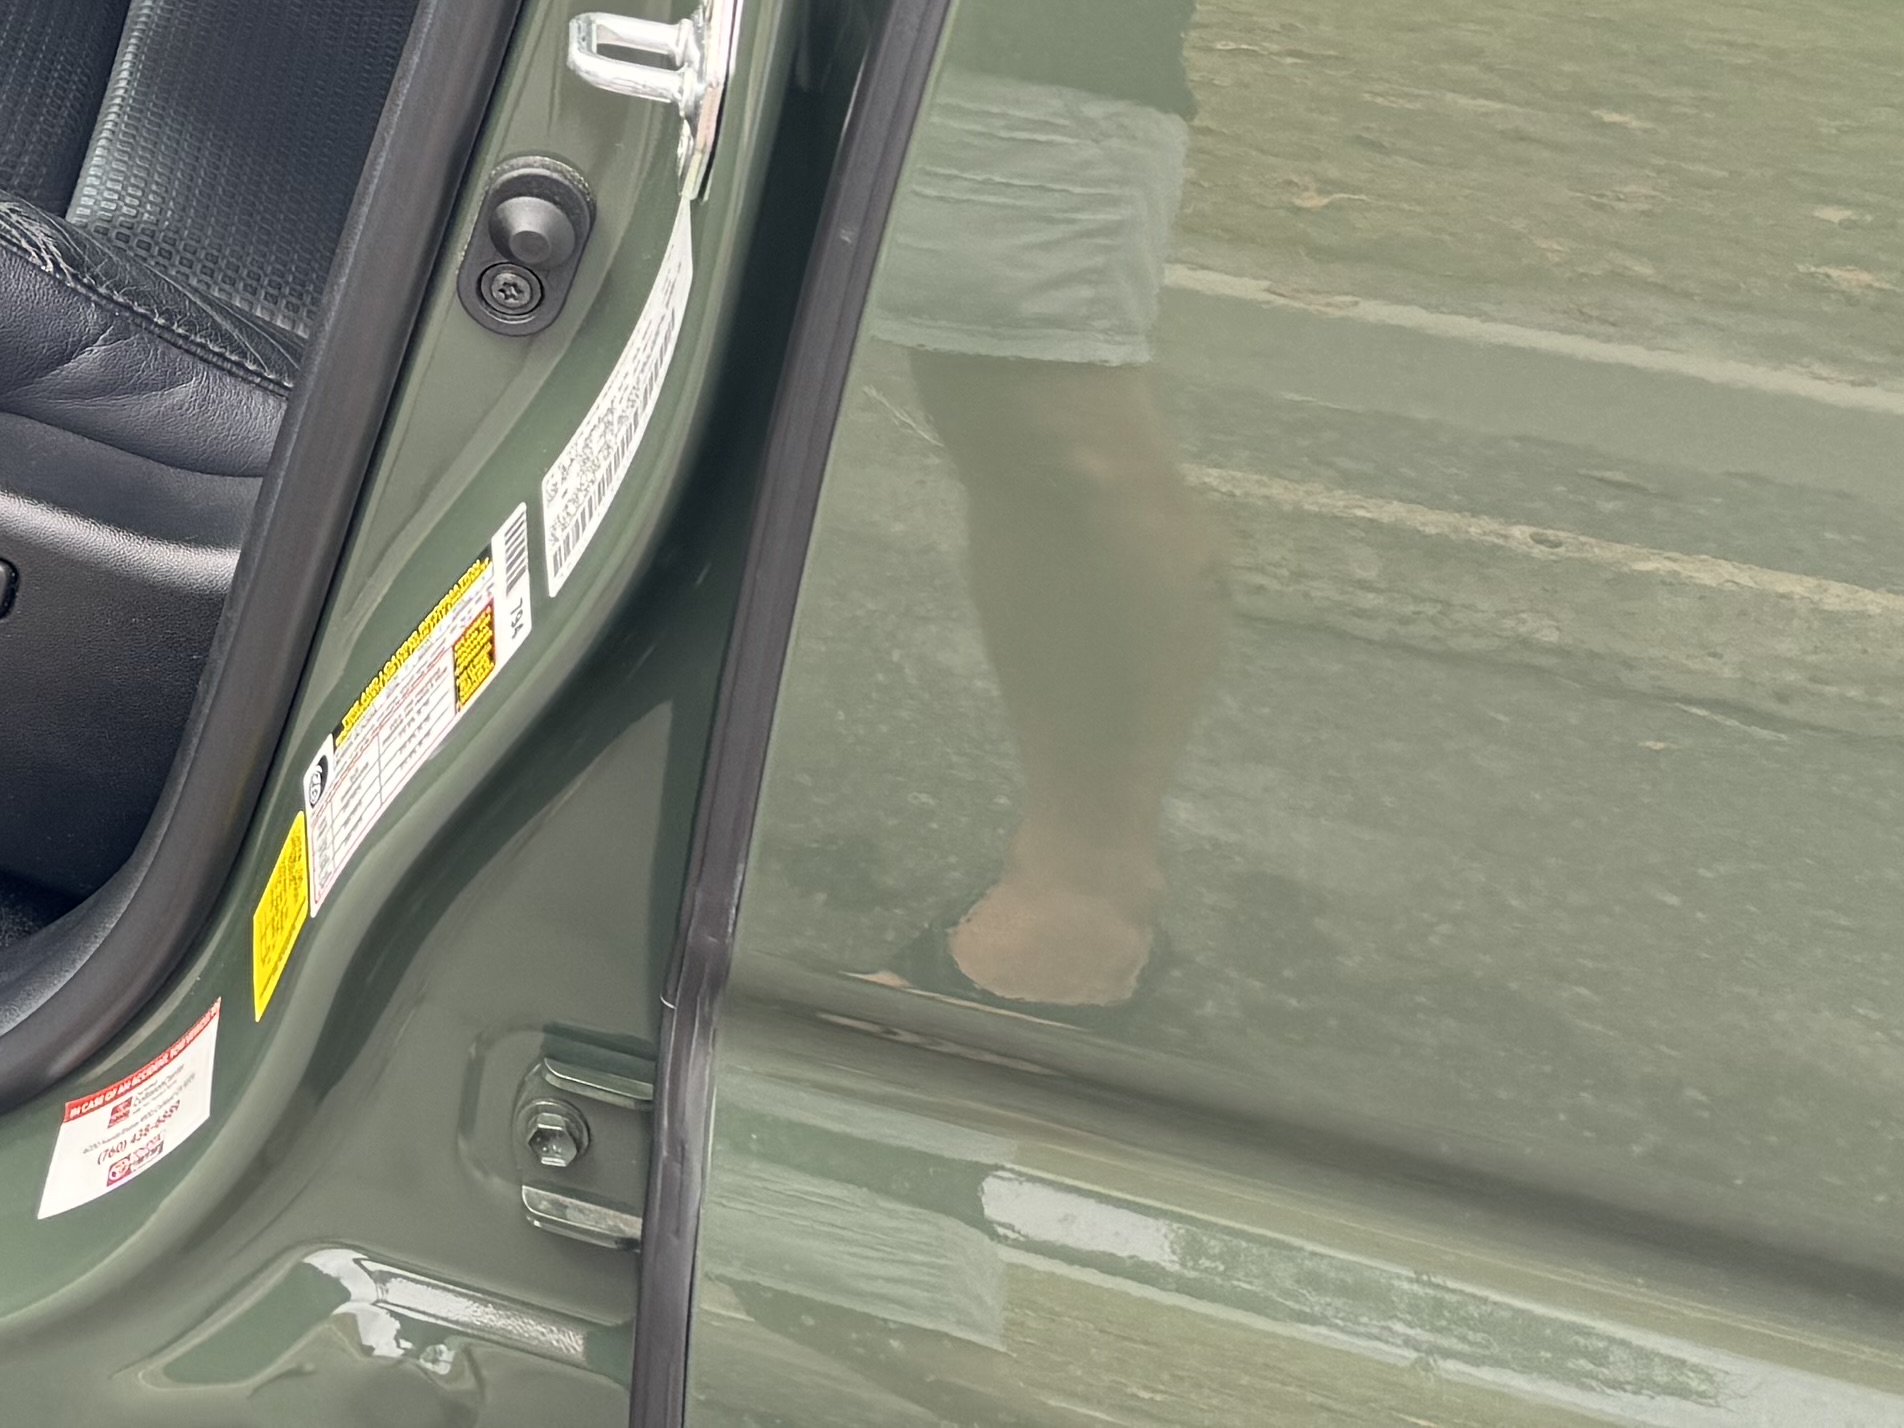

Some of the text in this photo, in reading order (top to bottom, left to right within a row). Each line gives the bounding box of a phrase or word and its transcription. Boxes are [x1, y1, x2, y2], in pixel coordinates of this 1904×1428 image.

[69, 1105, 81, 1119] IN
[82, 1097, 105, 1114] CASE
[105, 1089, 117, 1103] OF
[116, 1080, 133, 1098] AN
